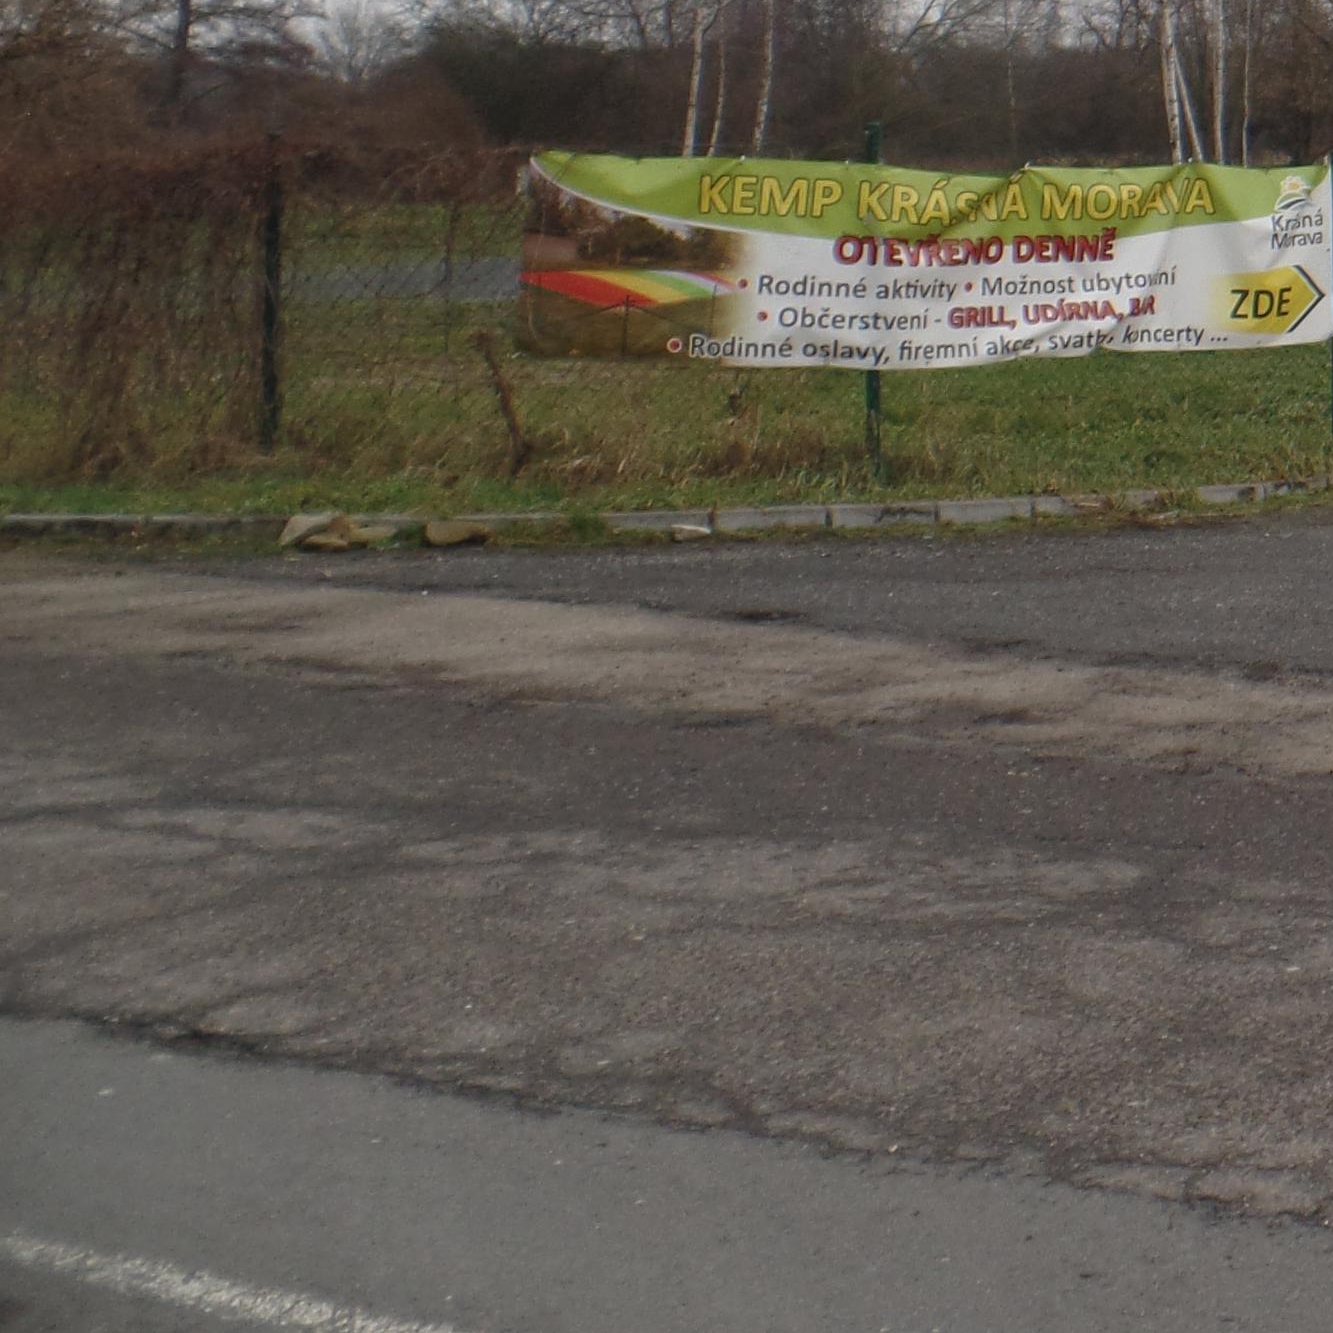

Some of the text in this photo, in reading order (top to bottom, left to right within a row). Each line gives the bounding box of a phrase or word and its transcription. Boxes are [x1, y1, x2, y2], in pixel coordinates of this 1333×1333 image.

[699, 171, 1216, 227] KEMP KRÁSNÁ MORAVA
[833, 227, 1118, 267] OTEVŘENO DENNĚ
[758, 275, 866, 299] Rodinné
[875, 276, 958, 302] aktivity
[981, 274, 1076, 297] Možnost
[1230, 286, 1292, 321] ZDE
[778, 307, 928, 330] Občerstvení
[947, 304, 1018, 334] GRILL,
[1022, 298, 1124, 326] UDÍRNA,
[689, 334, 793, 359] Rodinné
[802, 337, 890, 366] oslavy,
[900, 334, 979, 361] firemní
[987, 336, 1040, 357] akce,
